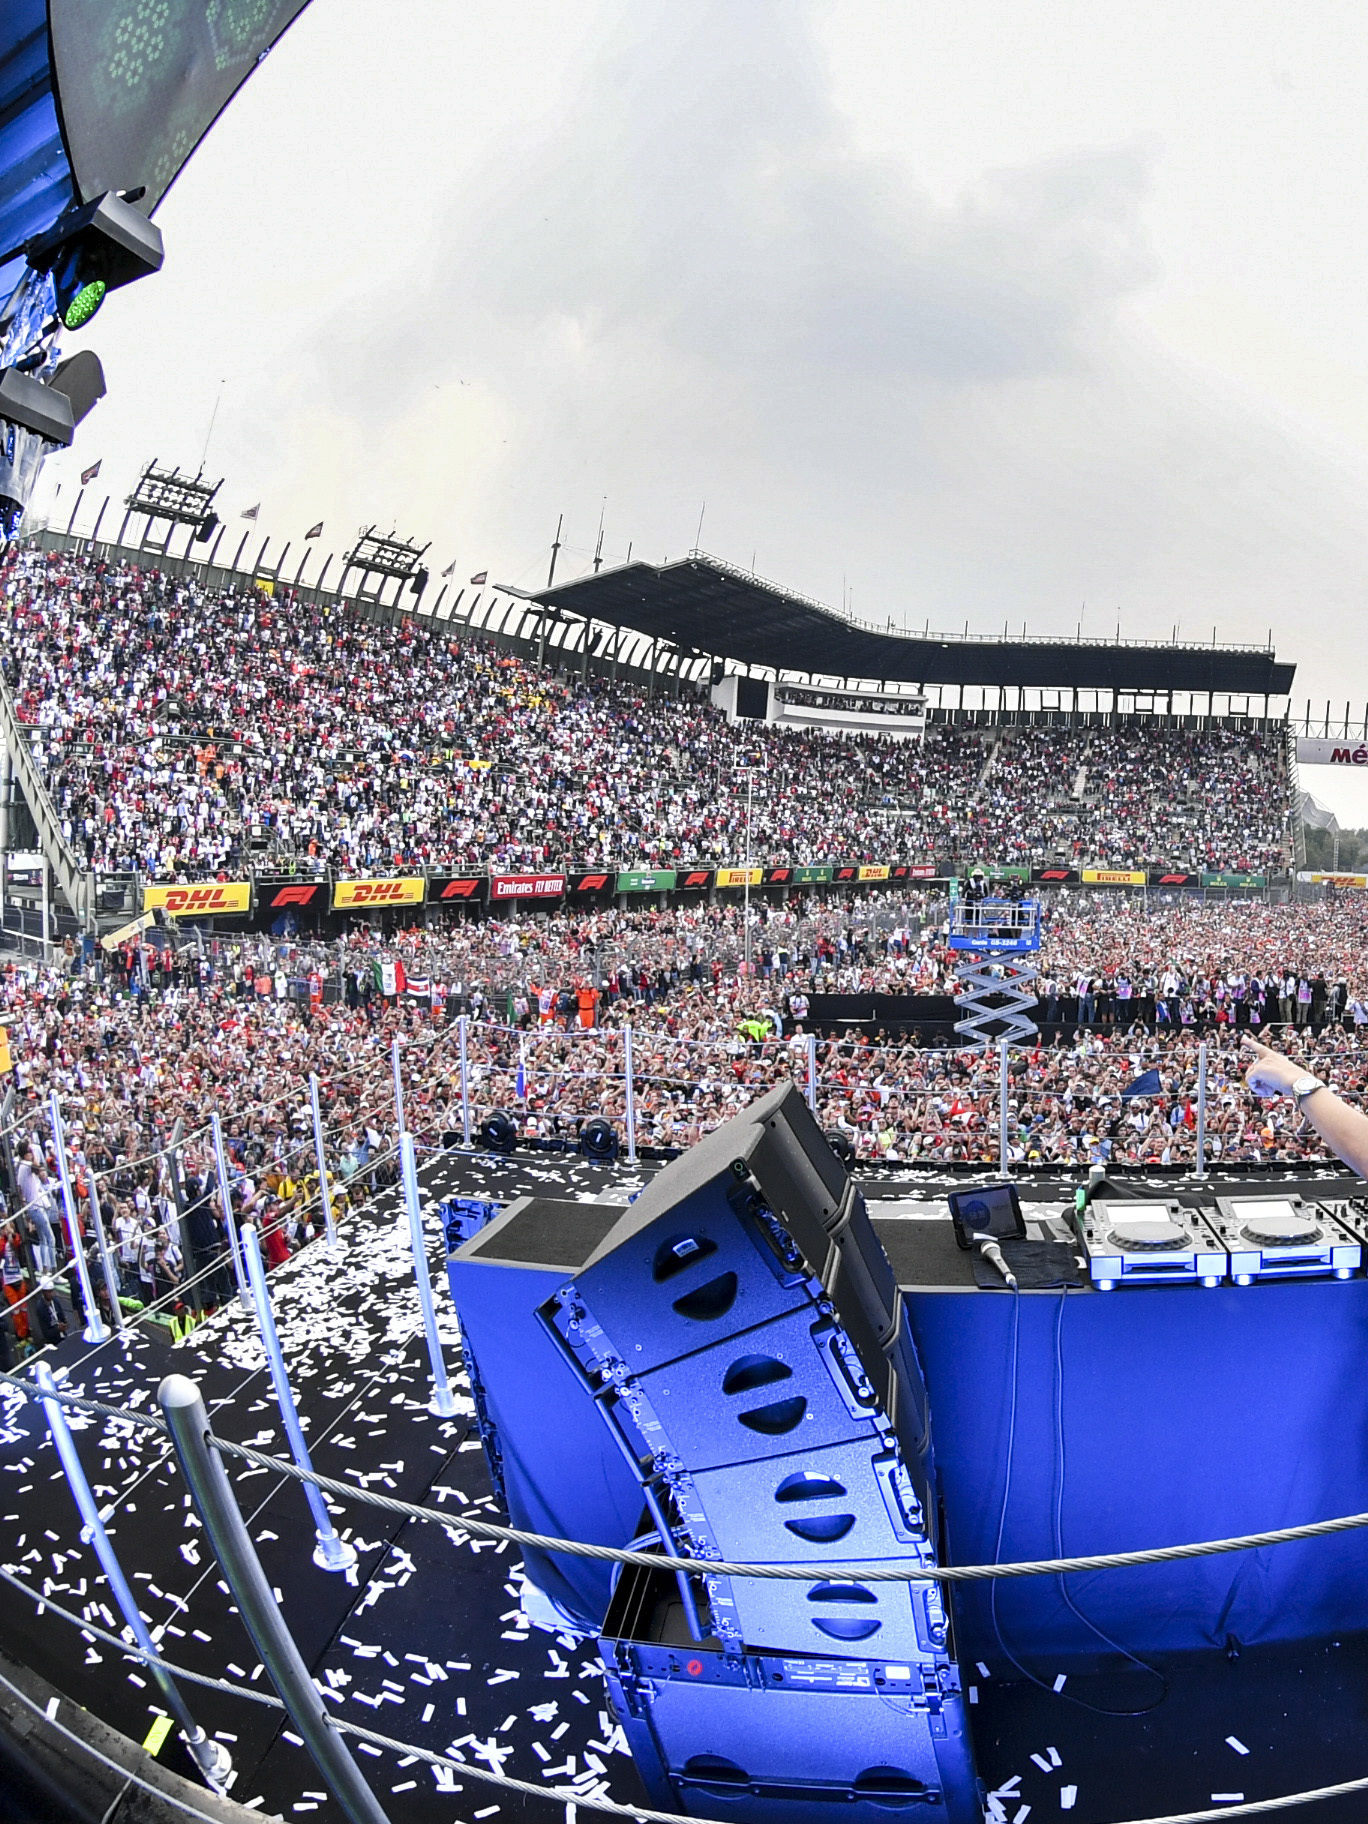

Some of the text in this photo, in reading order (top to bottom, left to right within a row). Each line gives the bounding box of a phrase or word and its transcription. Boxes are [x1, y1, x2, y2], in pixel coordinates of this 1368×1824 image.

[865, 868, 882, 878] DHL
[1097, 873, 1131, 882] PIRELLI
[352, 883, 404, 902] DHL
[497, 881, 533, 895] Emirates
[165, 889, 227, 910] DHL
